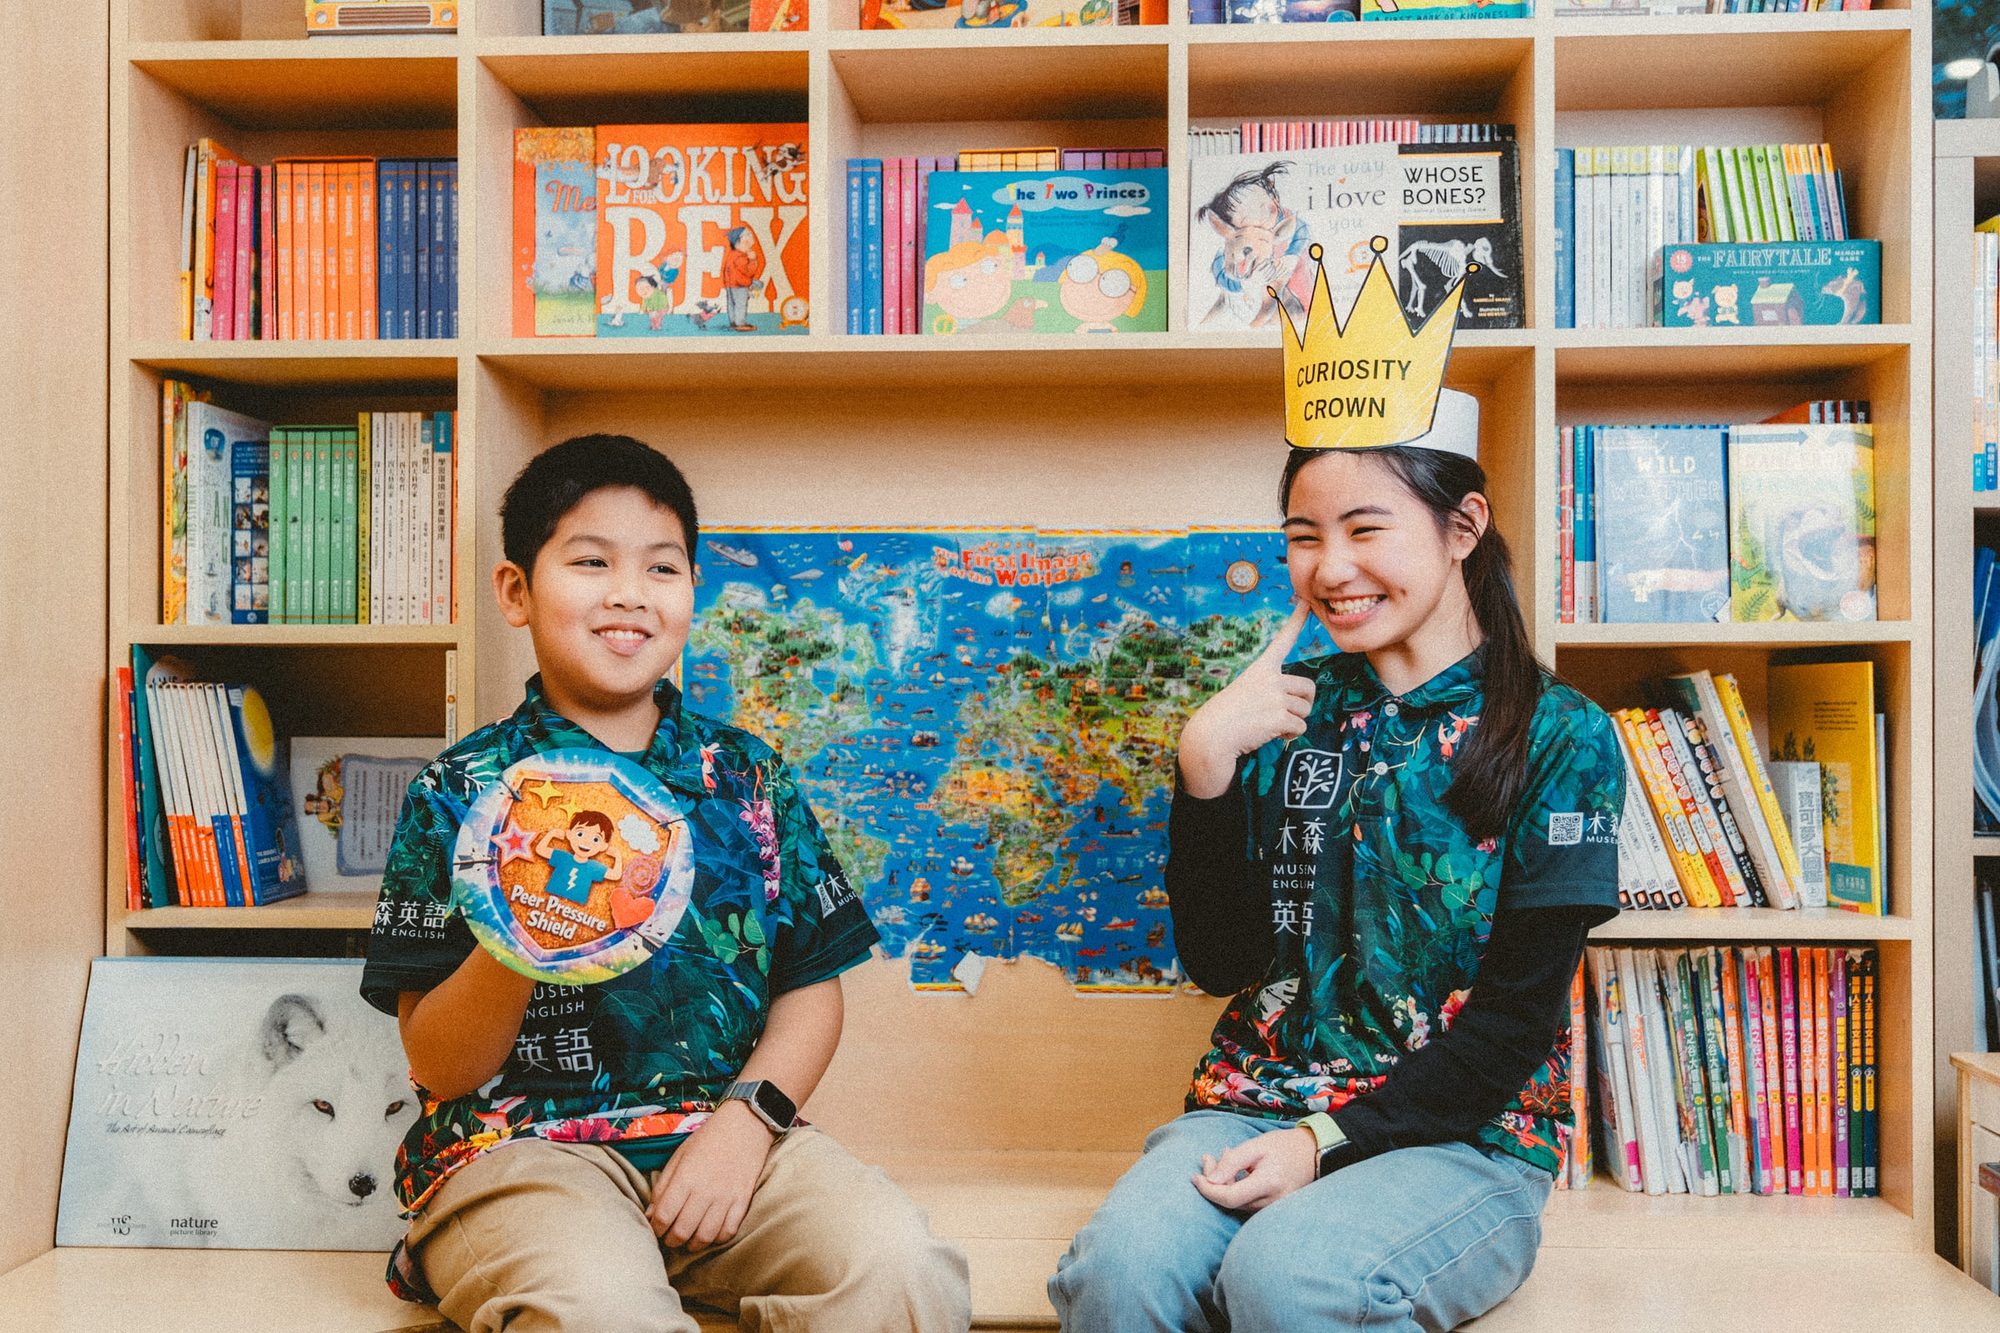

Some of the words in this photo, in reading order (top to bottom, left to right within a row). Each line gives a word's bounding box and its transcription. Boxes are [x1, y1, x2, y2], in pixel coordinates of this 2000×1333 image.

[1459, 11, 1510, 20] KINDNESS
[602, 143, 808, 204] LOOKING
[1343, 160, 1384, 177] way
[1403, 165, 1483, 184] WHOSE
[1007, 183, 1036, 200] The
[1045, 183, 1078, 200] Two
[1083, 183, 1146, 199] Princes
[1308, 186, 1313, 210] i
[1326, 183, 1386, 209] love
[1403, 187, 1486, 205] BONES?
[1329, 217, 1363, 235] you
[601, 205, 808, 314] REX
[1712, 247, 1832, 268] FAIRYTALE
[1296, 359, 1412, 388] CURIOSITY
[1304, 396, 1386, 421] CROWN
[1636, 456, 1697, 475] WILD
[961, 550, 1018, 570] First
[995, 569, 1067, 588] World
[1274, 816, 1327, 854] 木森
[510, 884, 545, 908] Peer
[546, 895, 607, 932] Pressure
[391, 928, 446, 941] ENGLISH
[526, 910, 577, 940] Shield
[529, 984, 584, 1002] USEN
[515, 1027, 594, 1073] 英語
[134, 1084, 263, 1119] Nature
[106, 1120, 120, 1133] The
[169, 1229, 194, 1237] picture
[195, 1228, 218, 1237] library
[170, 1217, 219, 1229] nature
